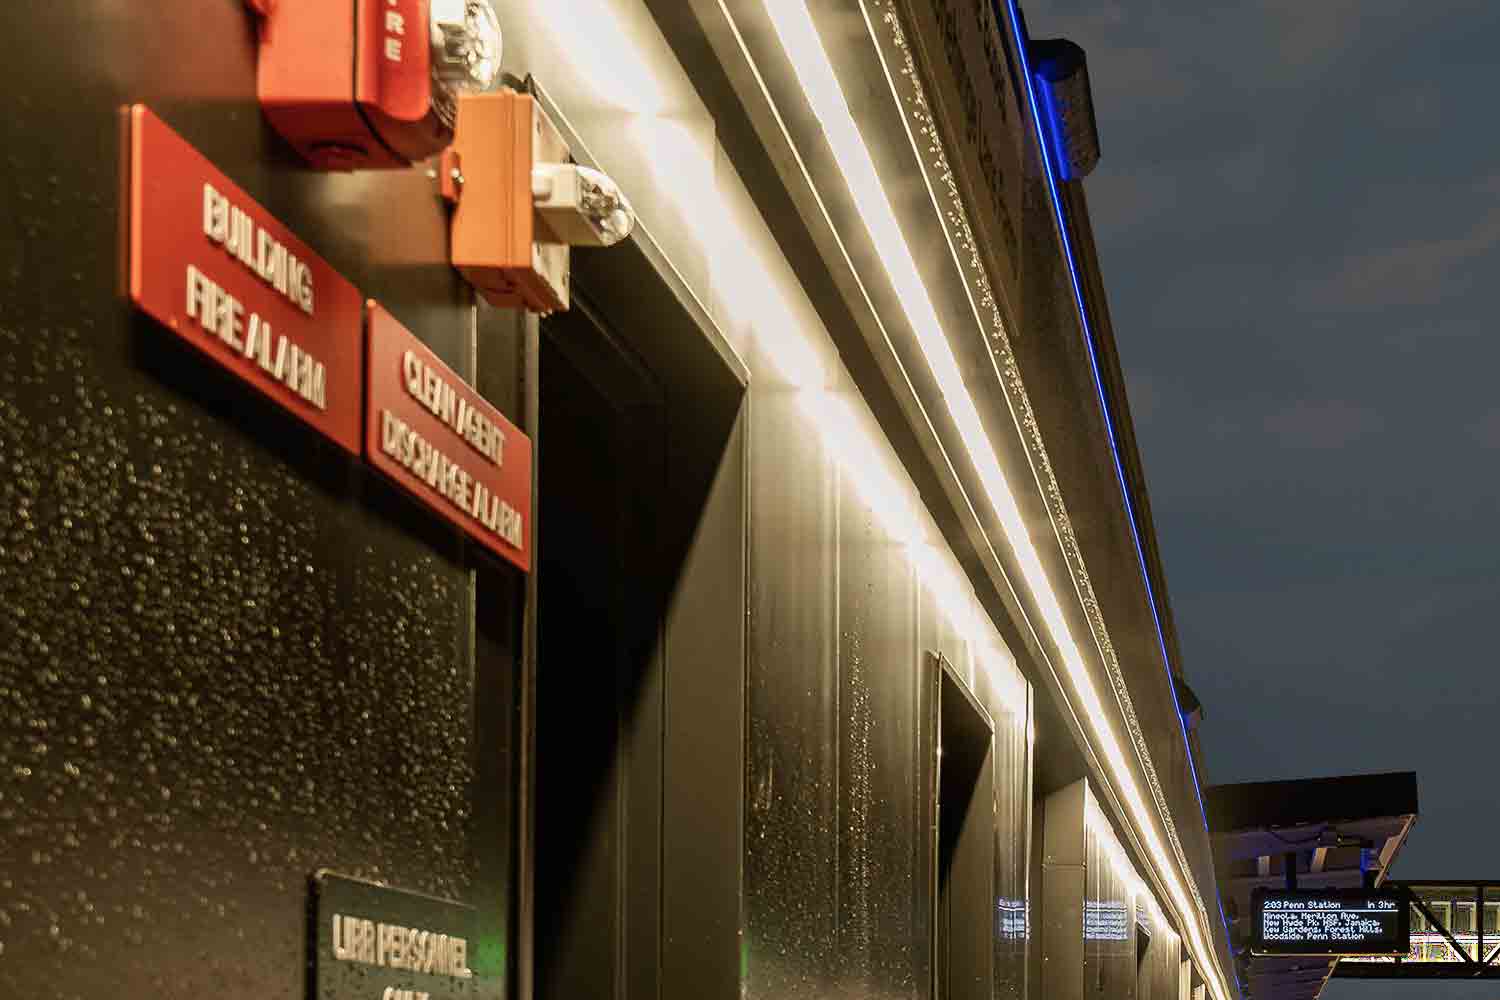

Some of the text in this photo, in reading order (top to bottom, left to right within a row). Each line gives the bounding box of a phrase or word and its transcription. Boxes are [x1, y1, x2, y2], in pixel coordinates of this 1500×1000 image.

[203, 183, 313, 315] BUILDING
[186, 264, 327, 410] FIRE ALARM
[404, 350, 504, 468] CLEAN AGENT
[382, 409, 522, 549] DISCHARGE ALARM
[1264, 919, 1280, 927] New
[1282, 919, 1304, 927] Hyde
[1283, 900, 1305, 909] Penn
[1307, 900, 1341, 909] Station
[1301, 912, 1338, 920] Merillon
[376, 922, 472, 979] PERSONNEL
[1306, 932, 1329, 940] Penn
[1331, 932, 1364, 940] Station
